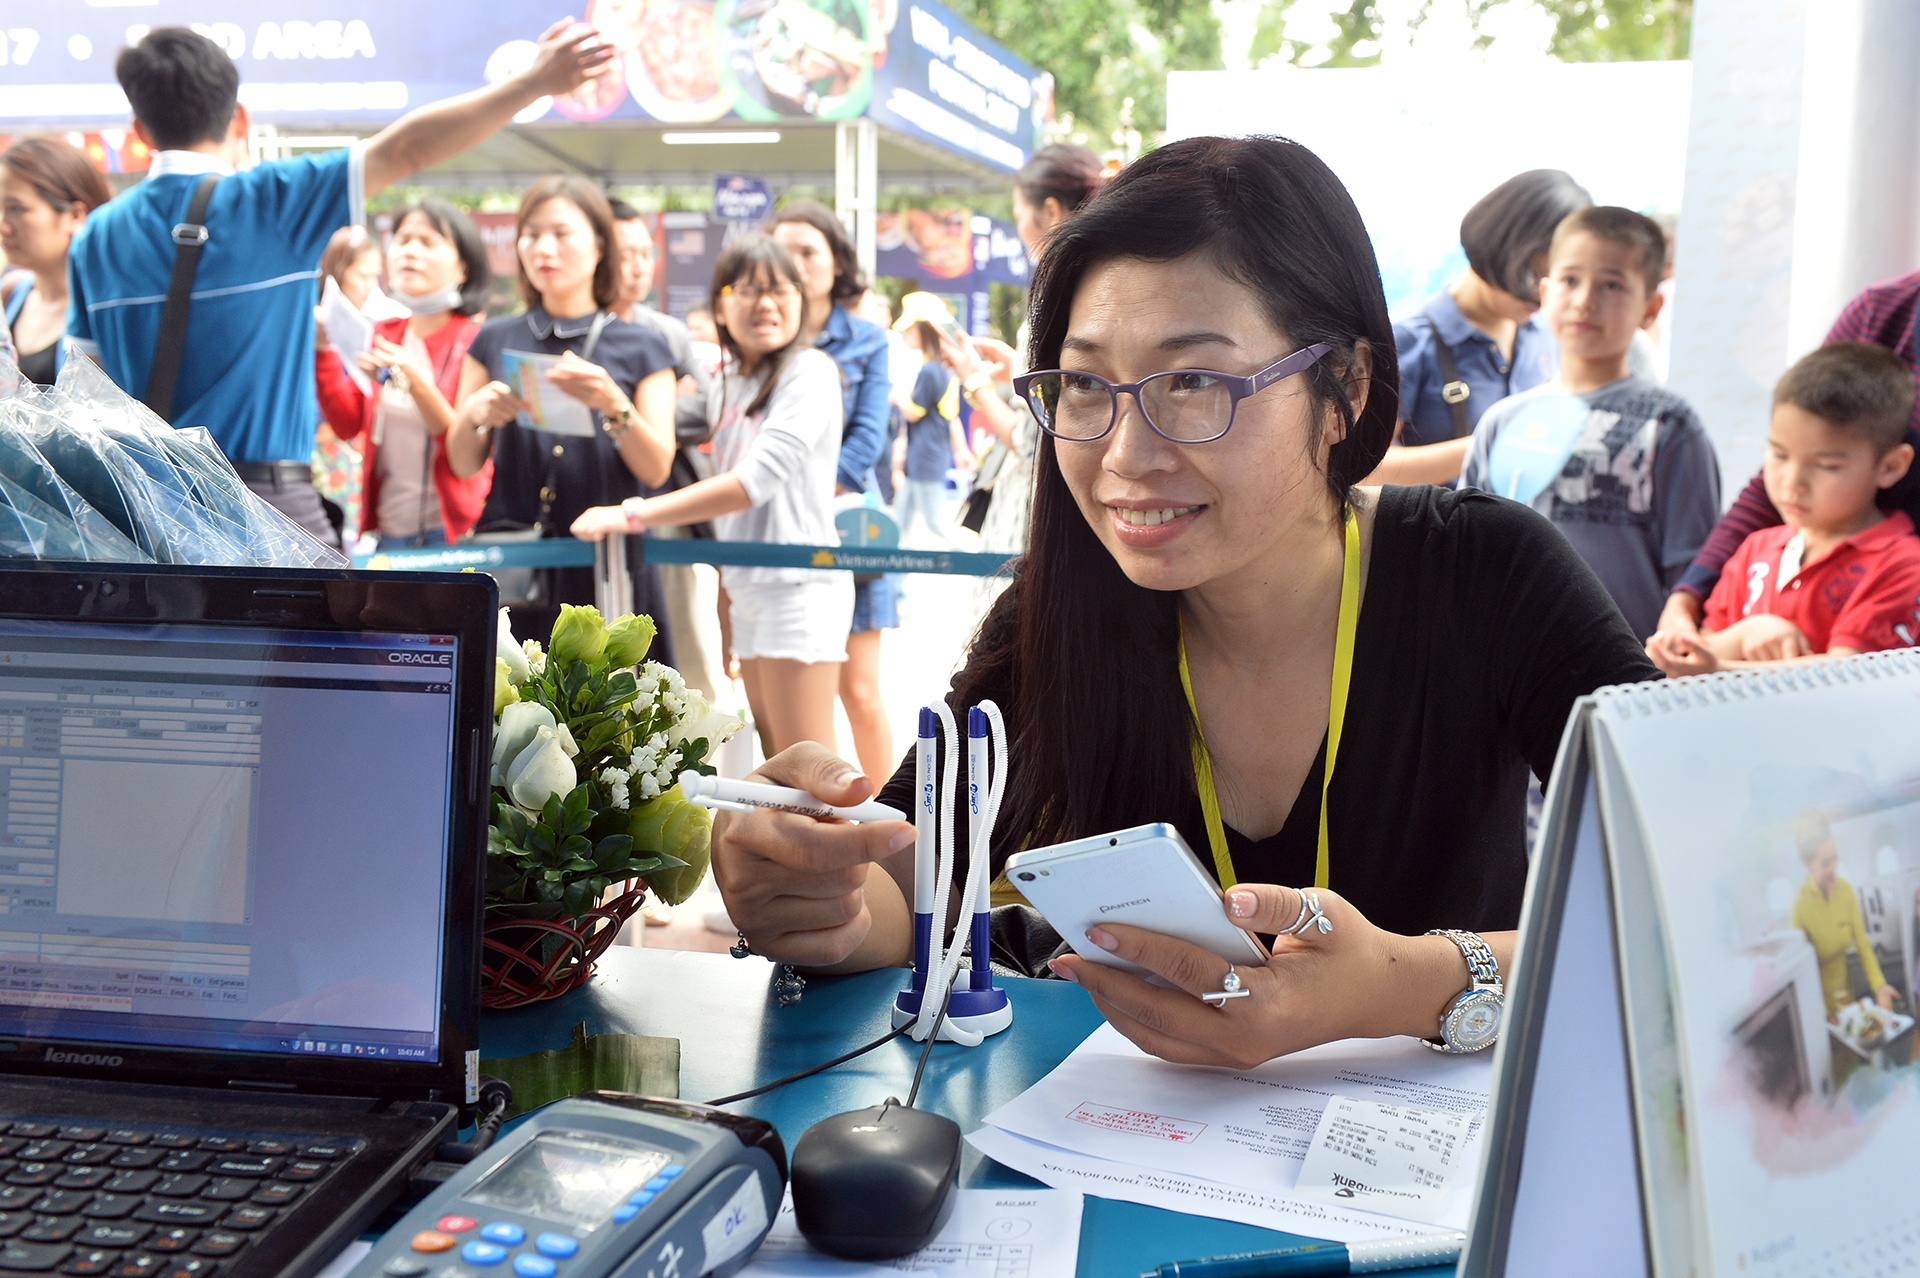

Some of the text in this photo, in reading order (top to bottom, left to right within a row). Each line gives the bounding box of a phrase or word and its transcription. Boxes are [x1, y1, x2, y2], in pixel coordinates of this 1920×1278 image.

[252, 19, 376, 60] AREA
[388, 652, 449, 664] ORACLE
[1098, 897, 1151, 913] PANTECH
[45, 1047, 124, 1068] lenovo
[397, 1048, 412, 1056] 10:43
[1126, 1111, 1159, 1120] PAID
[1089, 1119, 1165, 1137] Vietnam Airlines
[1331, 1170, 1423, 1201] Vietcombank
